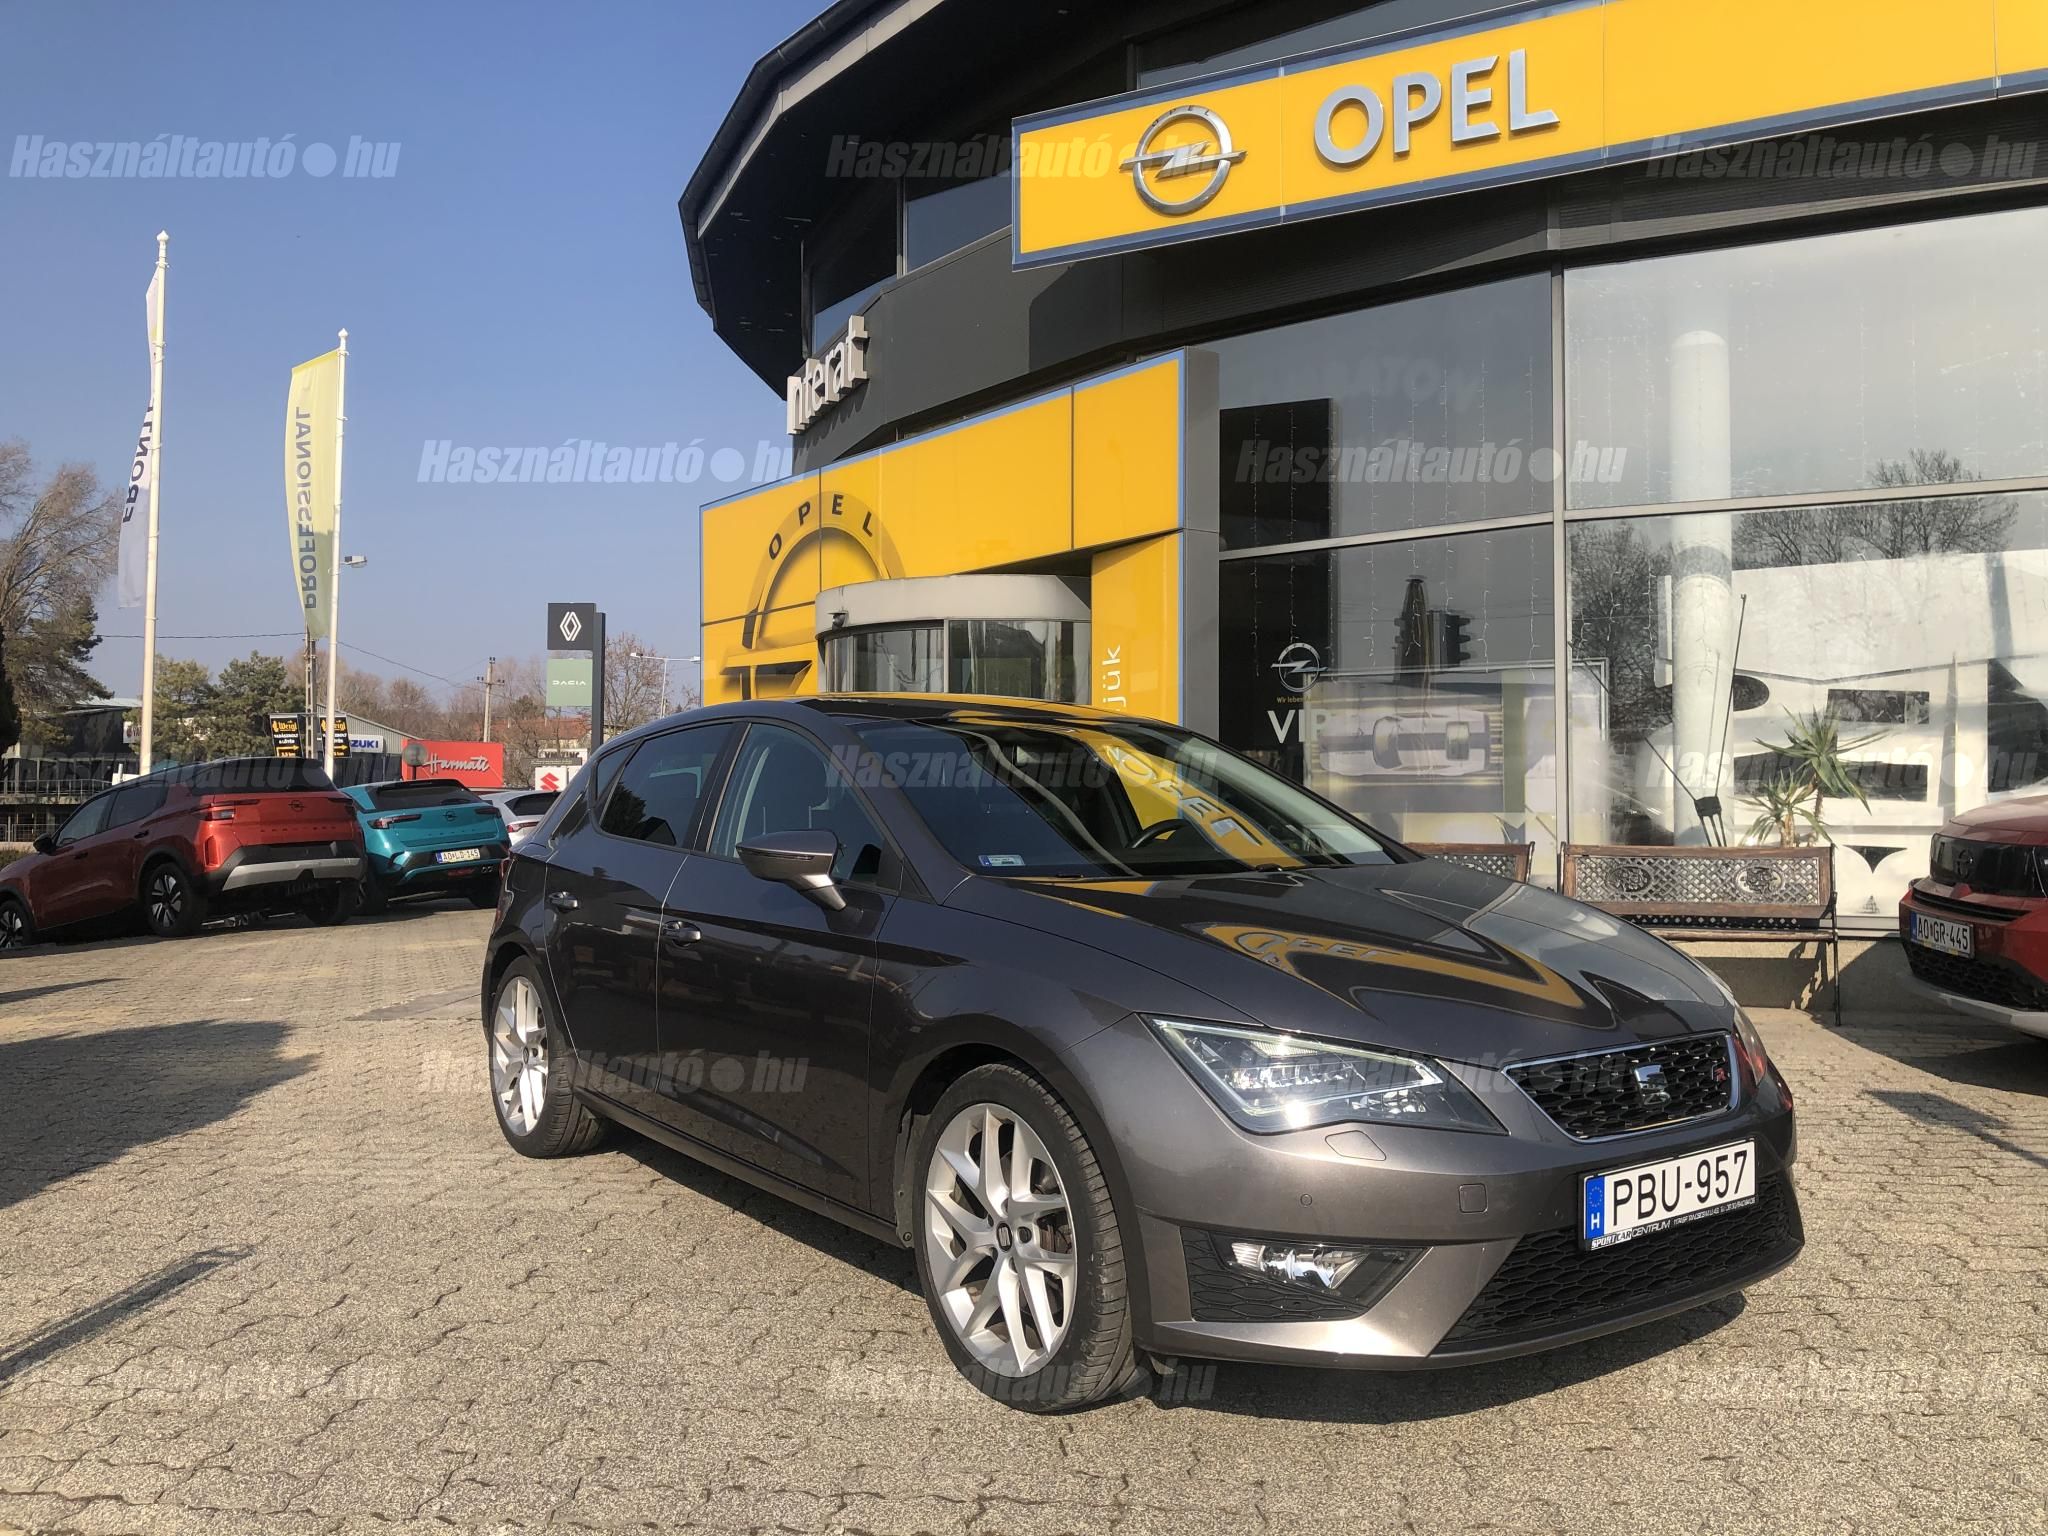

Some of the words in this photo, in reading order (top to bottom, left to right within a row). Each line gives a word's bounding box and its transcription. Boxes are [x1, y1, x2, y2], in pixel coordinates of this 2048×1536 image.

[1151, 104, 1210, 127] OPEL
[1314, 47, 1561, 165] OPEL
[768, 493, 873, 560] OPEL
[1102, 644, 1127, 711] jük
[350, 740, 379, 748] ZUKI
[1591, 1212, 1600, 1230] H
[1613, 1150, 1748, 1226] PBU-957
